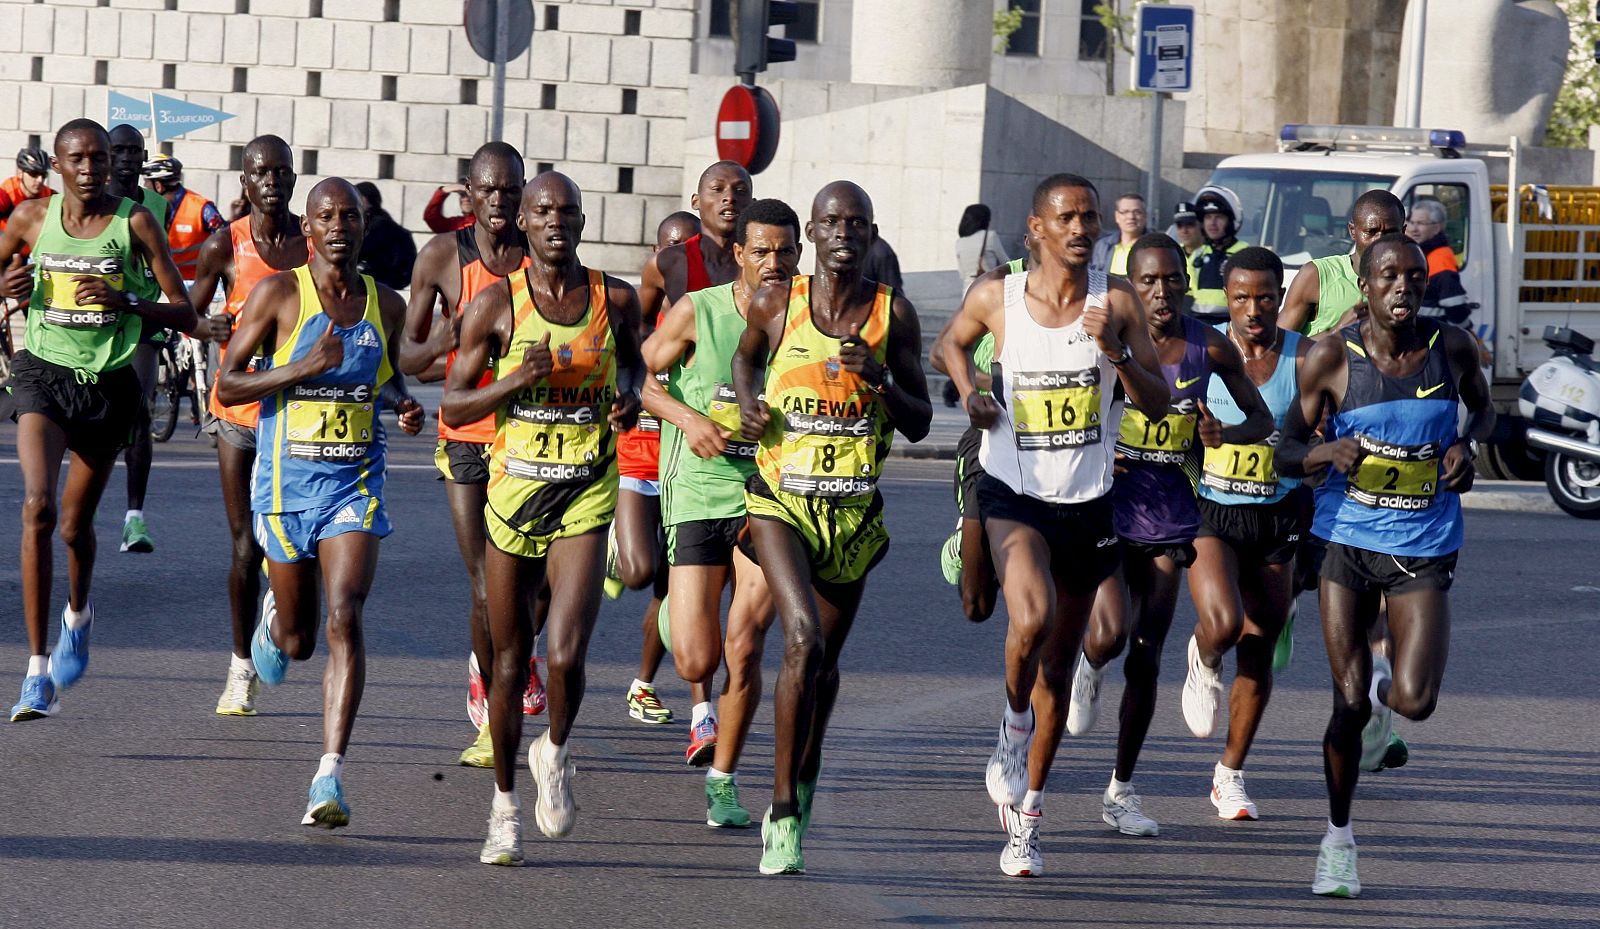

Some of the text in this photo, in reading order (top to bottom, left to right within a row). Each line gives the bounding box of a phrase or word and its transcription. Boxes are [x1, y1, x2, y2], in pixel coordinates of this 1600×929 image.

[167, 114, 214, 123] CLASIFICADO
[45, 256, 91, 270] iberCaja
[71, 312, 116, 324] adidas
[1015, 374, 1067, 387] iberCaja
[295, 386, 344, 399] iberCaja
[1561, 384, 1585, 403] 112
[513, 405, 563, 422] iberCaja
[1044, 397, 1076, 428] 16
[320, 409, 348, 439] 13
[789, 413, 843, 432] iberCaja
[361, 429, 368, 438] A
[1052, 429, 1098, 445] adidas
[1142, 420, 1170, 447] 10
[322, 444, 367, 457] adidas
[535, 432, 564, 459] 21
[585, 451, 593, 461] A
[821, 443, 837, 473] 8
[1142, 450, 1185, 464] adidas
[862, 464, 870, 473] A
[1232, 451, 1260, 477] 12
[540, 465, 590, 479] adidas
[1383, 466, 1400, 491] 2
[818, 478, 870, 492] adidas
[1231, 480, 1274, 495] adidas
[1423, 483, 1430, 491] A
[1379, 496, 1429, 509] adidas
